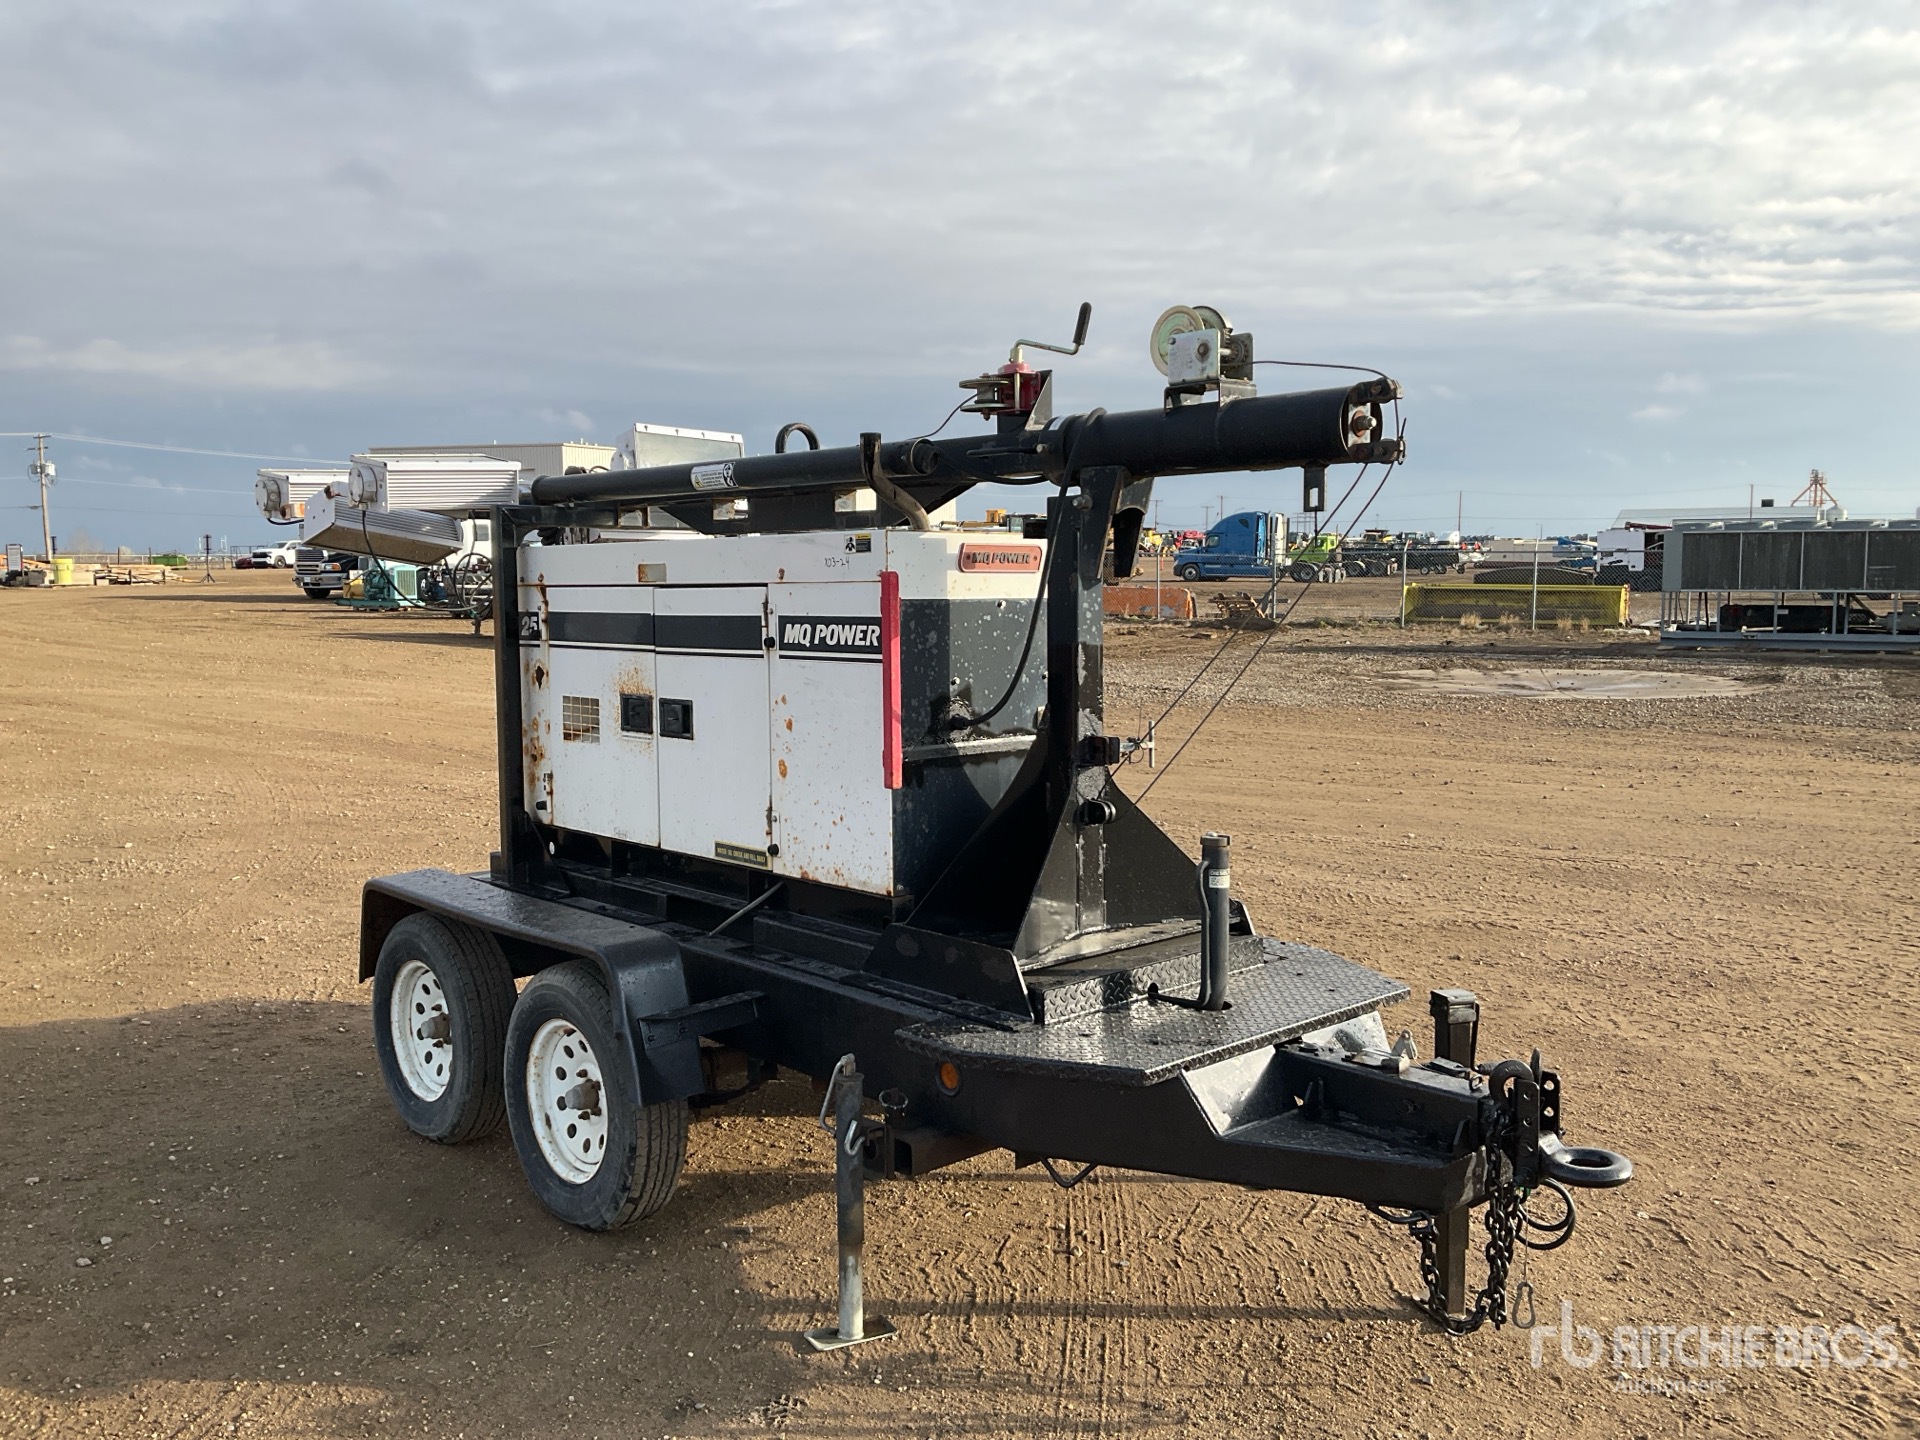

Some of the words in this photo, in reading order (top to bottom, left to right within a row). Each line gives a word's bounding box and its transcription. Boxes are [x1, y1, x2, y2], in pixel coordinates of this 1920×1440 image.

[972, 551, 990, 565] MQ
[991, 551, 1030, 564] POWER
[783, 623, 812, 648] MQ
[813, 624, 880, 646] POWER
